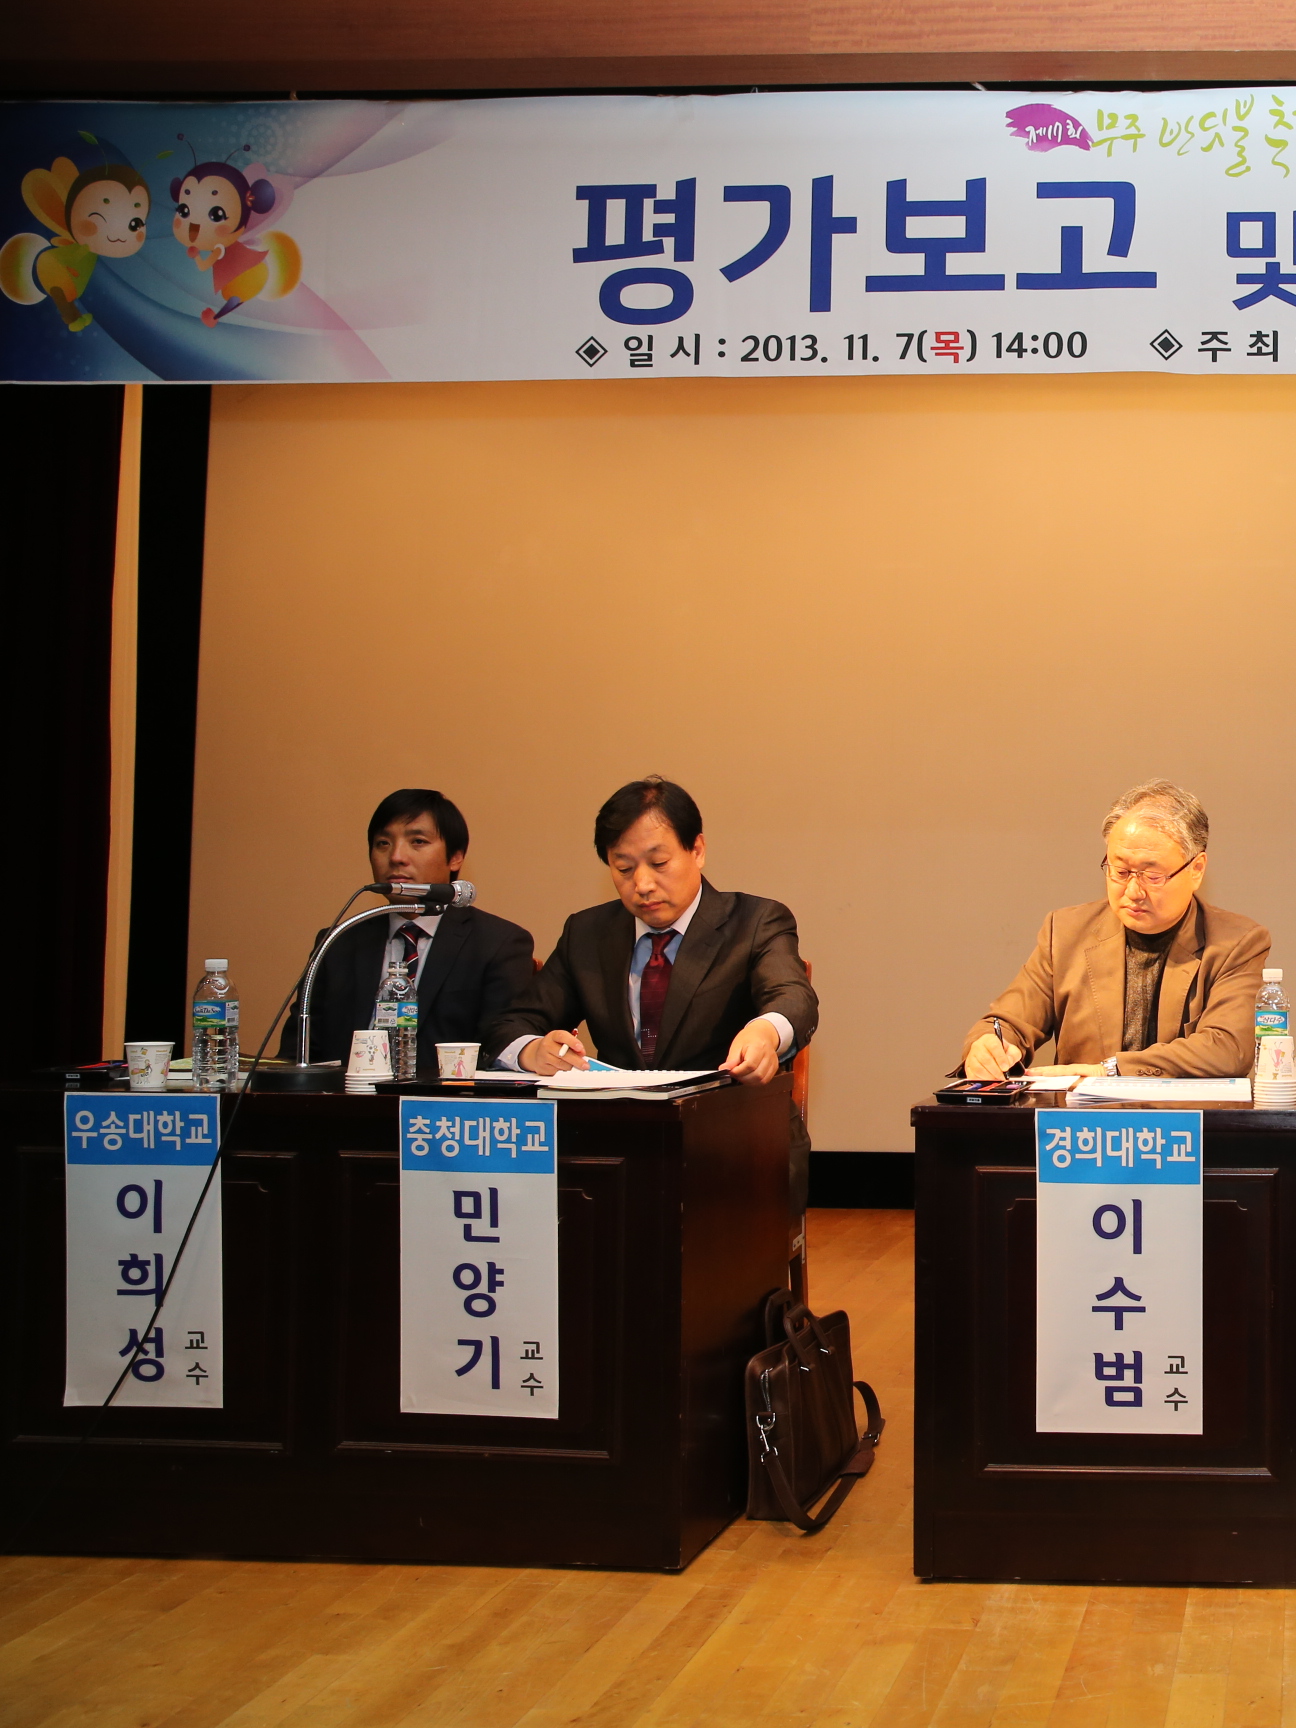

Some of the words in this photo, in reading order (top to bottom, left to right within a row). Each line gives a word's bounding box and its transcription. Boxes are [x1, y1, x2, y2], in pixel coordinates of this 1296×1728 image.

[1092, 109, 1146, 157] 무주
[573, 175, 1157, 325] 평가보고
[741, 335, 828, 364] 2013.
[844, 334, 880, 363] 11.
[895, 330, 977, 364] 7(목)
[991, 331, 1088, 359] 14:00
[71, 1110, 212, 1150] 우송대학교
[406, 1116, 550, 1158] 충청대학교
[1044, 1126, 1196, 1169] 경희대학교
[452, 1187, 505, 1390] 민양기
[1091, 1199, 1146, 1408] 이수범
[184, 1331, 209, 1386] 교수
[520, 1341, 544, 1396] 교수
[1164, 1355, 1189, 1412] 교수
